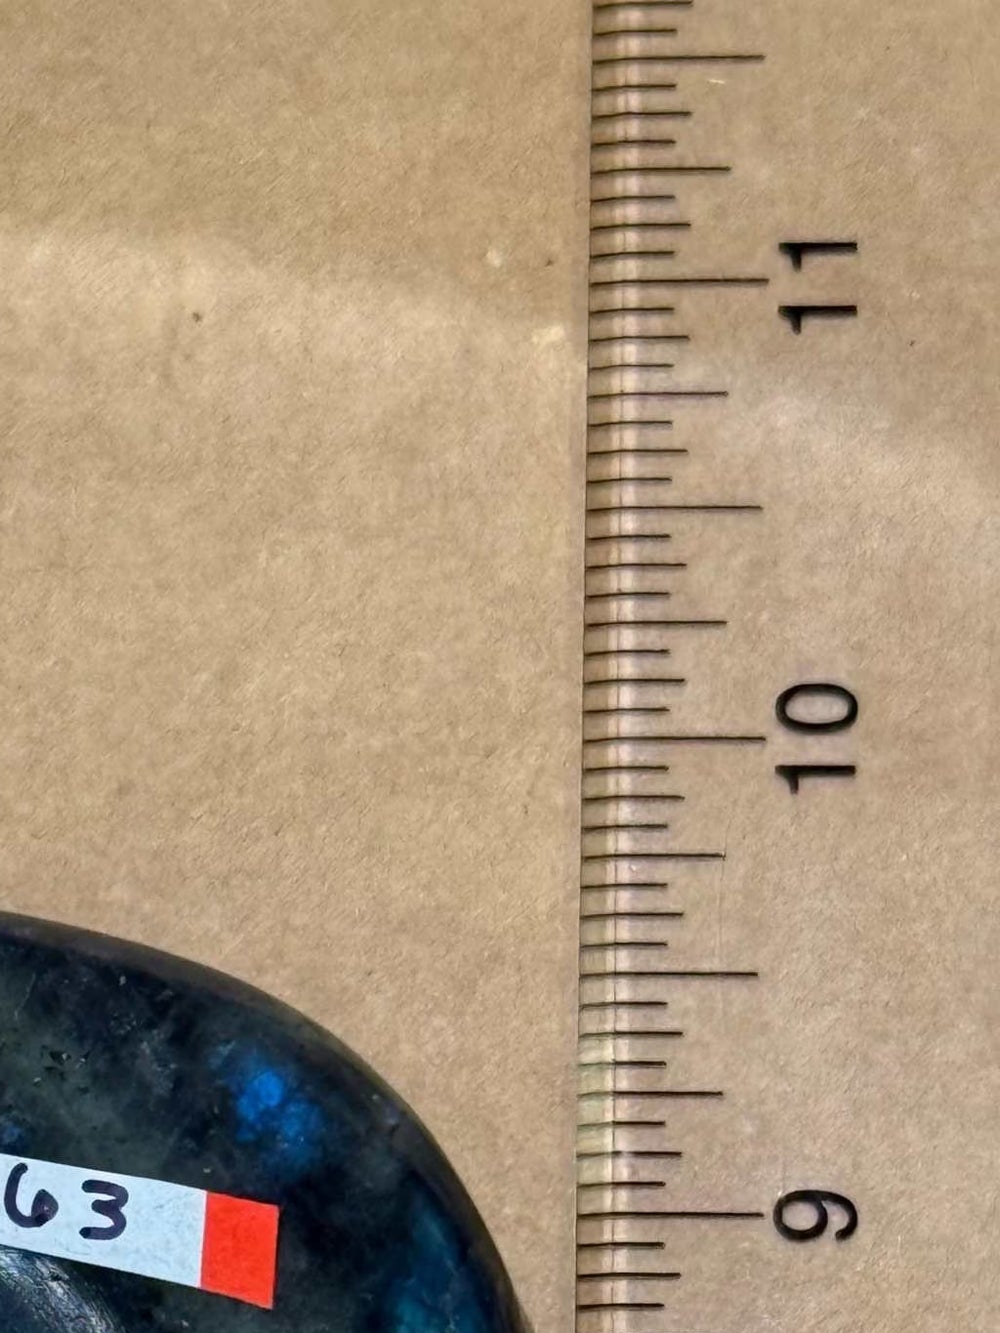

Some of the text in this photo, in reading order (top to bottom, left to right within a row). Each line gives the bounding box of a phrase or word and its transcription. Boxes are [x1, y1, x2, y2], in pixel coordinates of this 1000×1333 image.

[777, 241, 859, 335] 11
[774, 682, 859, 794] 10
[773, 1189, 859, 1244] 9
